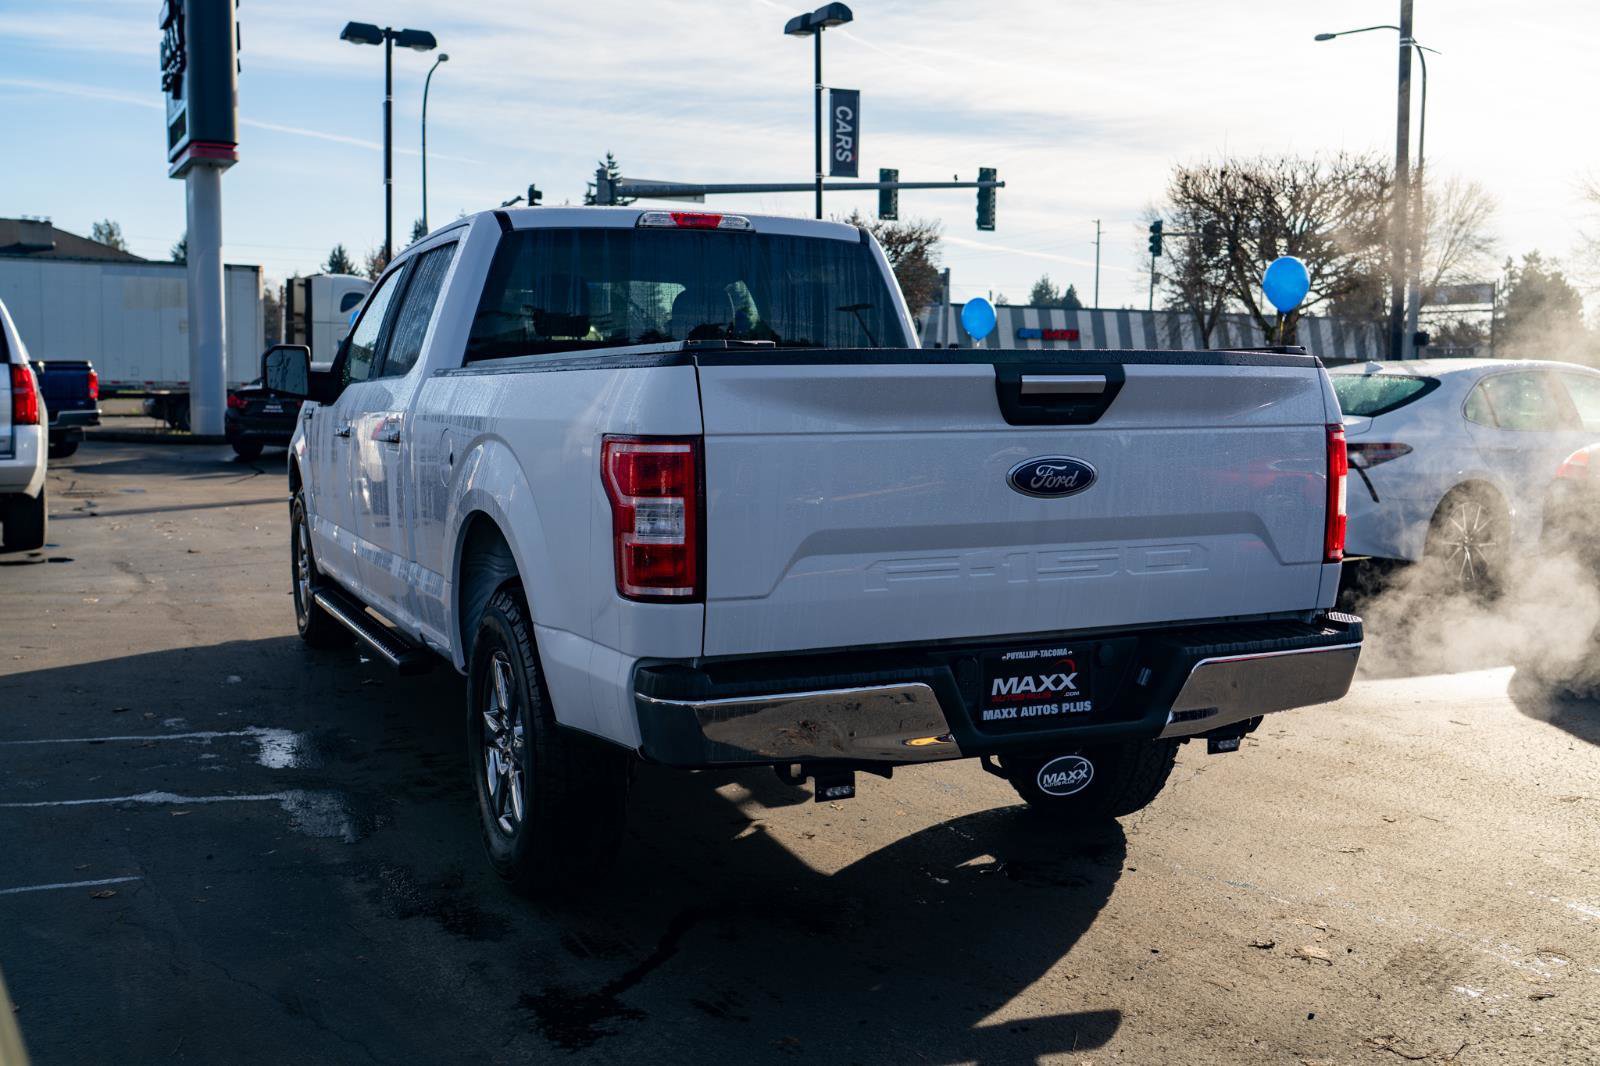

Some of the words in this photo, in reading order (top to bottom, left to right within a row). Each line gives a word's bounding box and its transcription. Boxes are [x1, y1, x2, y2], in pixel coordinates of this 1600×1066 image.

[836, 106, 853, 162] CARS
[1030, 464, 1080, 489] Ford
[863, 542, 1210, 593] F-150
[1006, 648, 1068, 660] PUYALLUP-TACOMA
[992, 672, 1078, 695] MAXX
[983, 708, 1017, 720] MAXX
[1021, 704, 1058, 717] AUTOS
[1062, 701, 1092, 713] PLUS
[1042, 768, 1088, 785] MAXX
